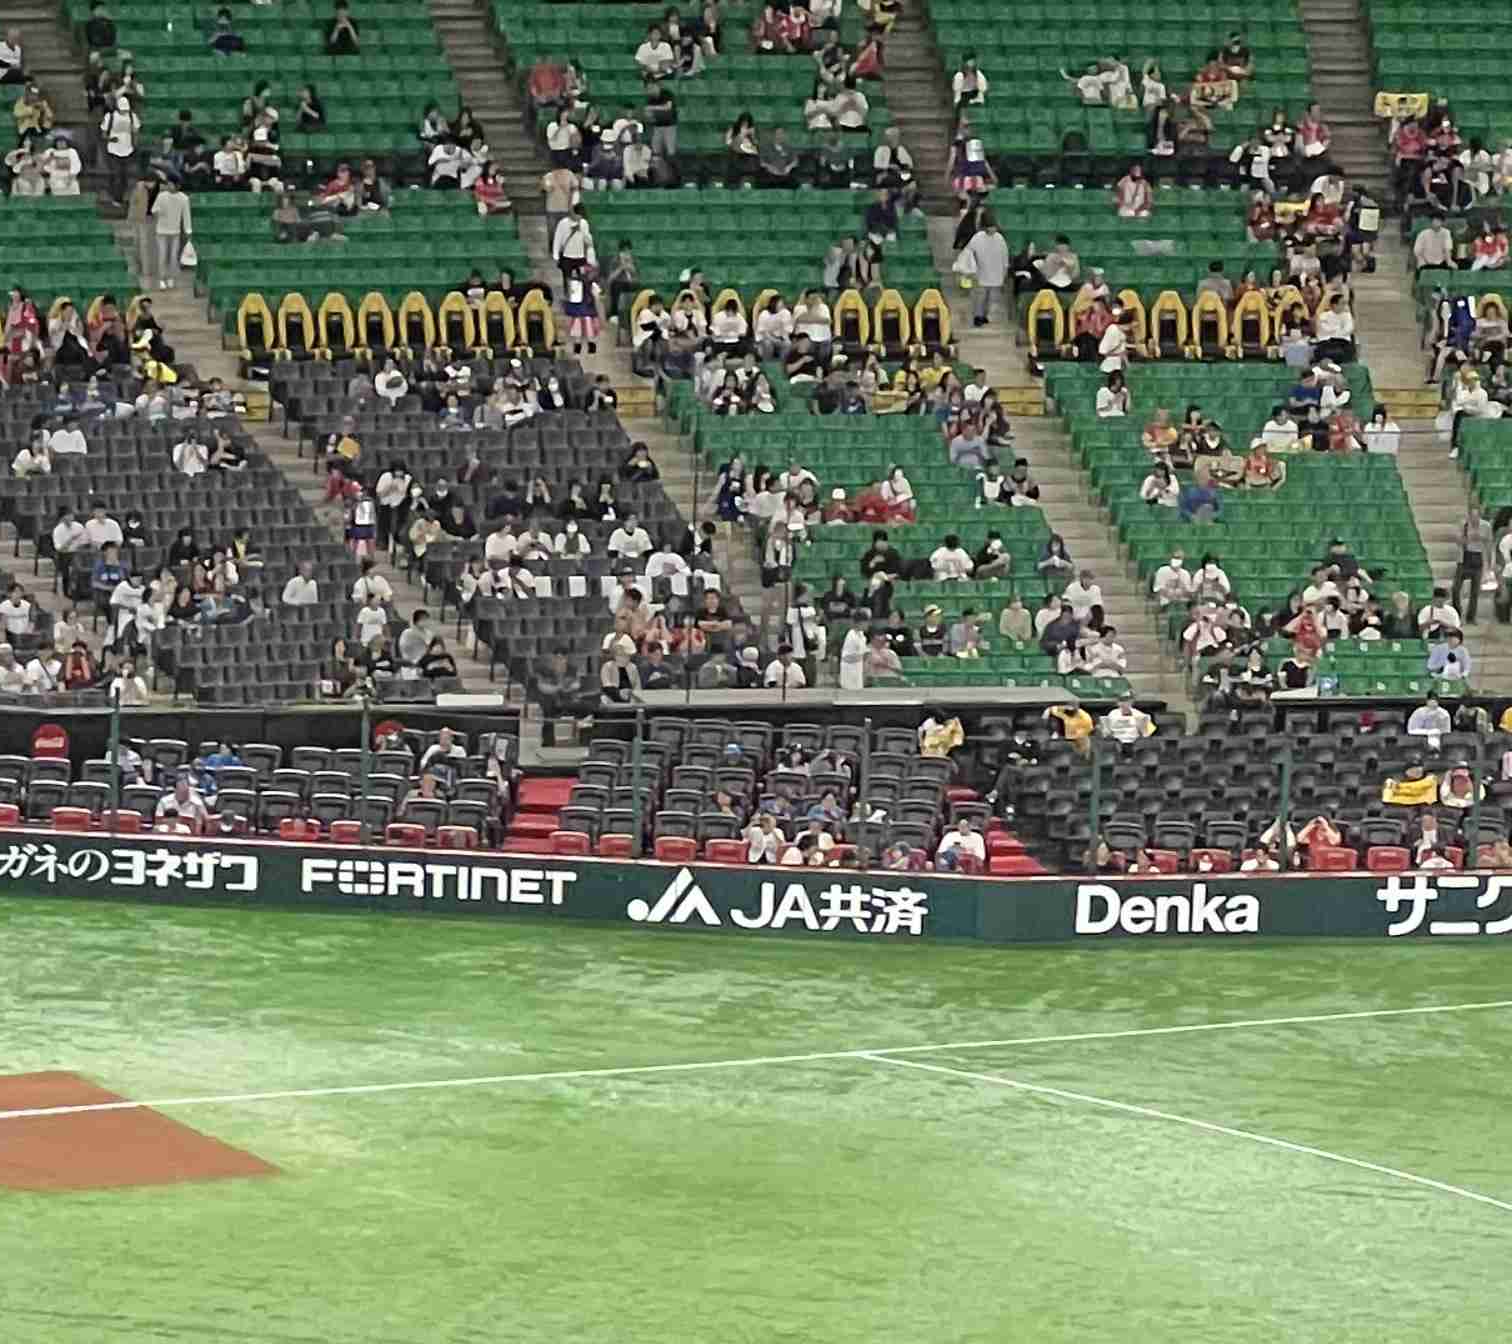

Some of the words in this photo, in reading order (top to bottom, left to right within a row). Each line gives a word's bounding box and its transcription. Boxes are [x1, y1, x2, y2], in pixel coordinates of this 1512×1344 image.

[301, 858, 577, 905] FORTINET
[730, 881, 928, 935] JA共済
[1075, 884, 1260, 934] Denka
